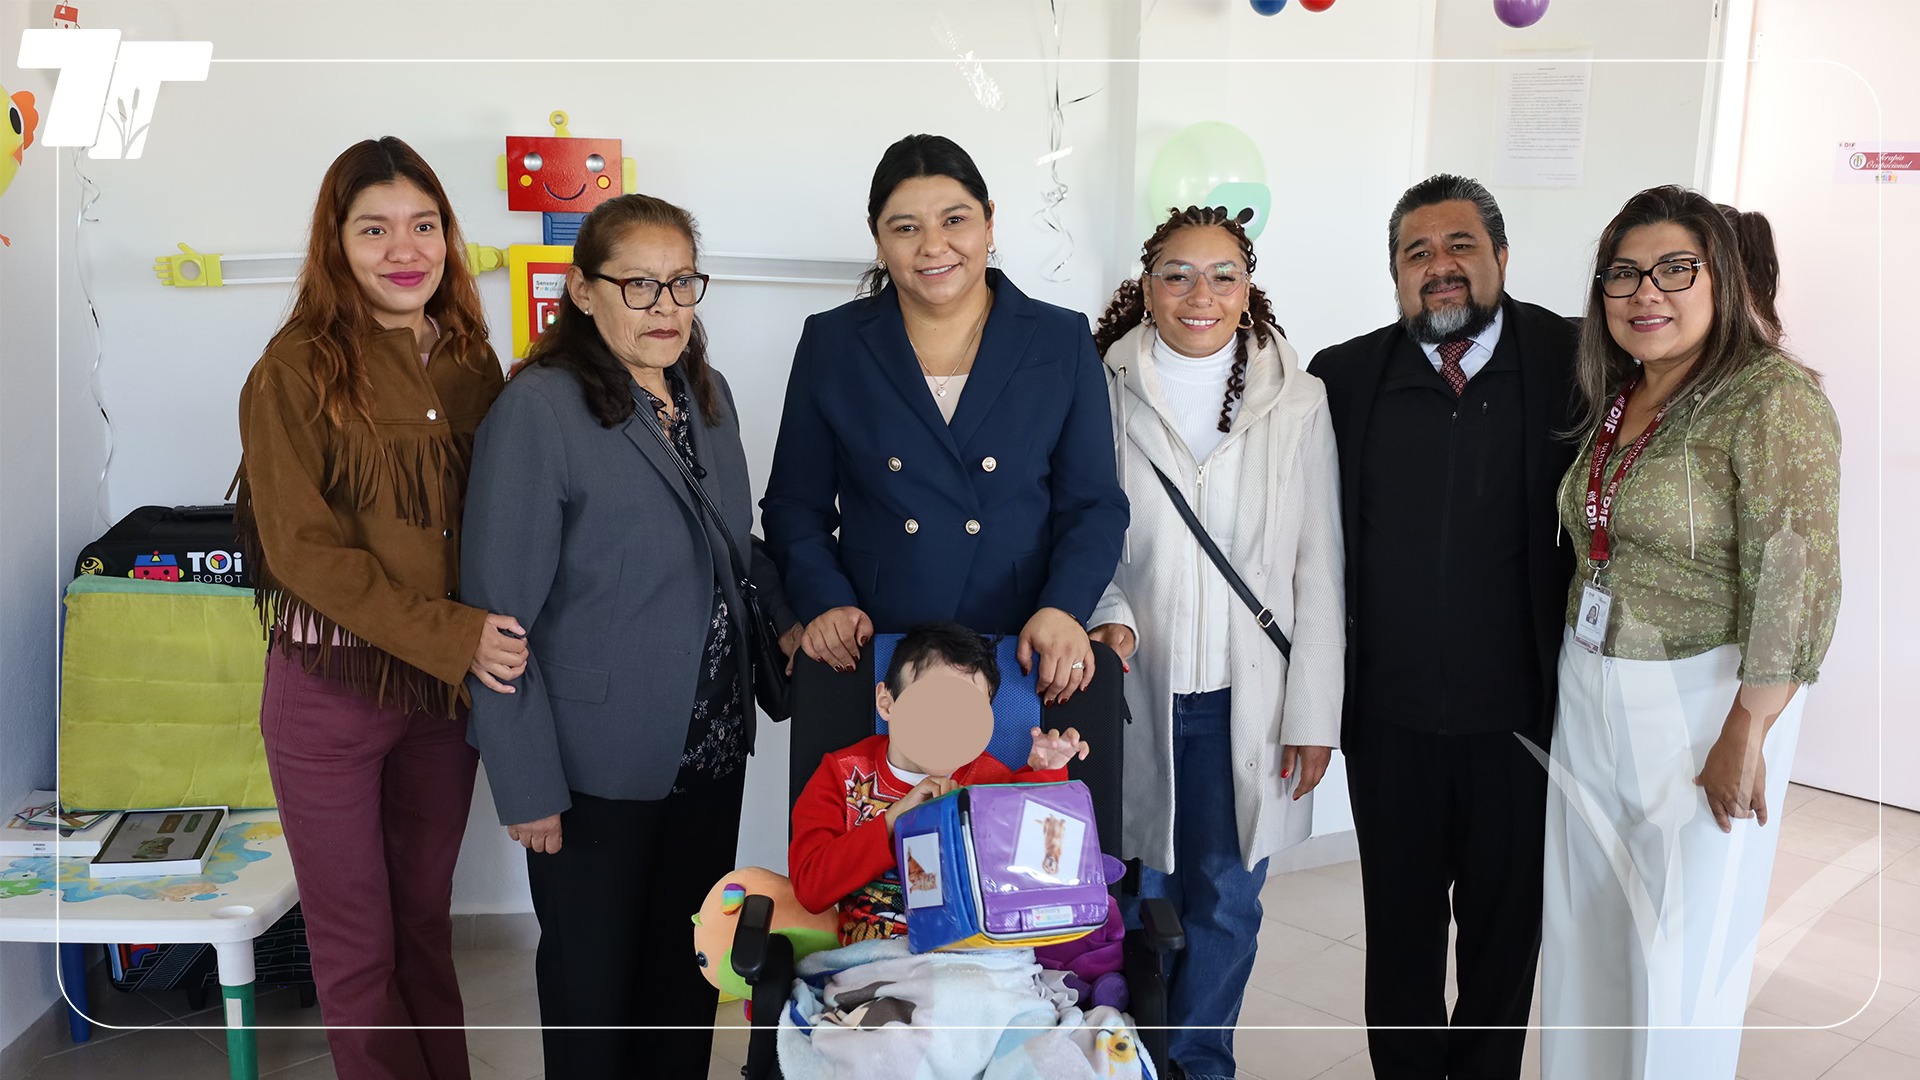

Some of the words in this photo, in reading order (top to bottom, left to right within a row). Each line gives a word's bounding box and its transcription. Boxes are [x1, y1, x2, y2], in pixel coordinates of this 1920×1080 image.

[1604, 406, 1622, 434] DIF
[1594, 442, 1610, 478] TULTITLAN
[1598, 496, 1612, 528] DIF
[187, 550, 242, 574] TOi
[193, 575, 243, 583] ROBOT
